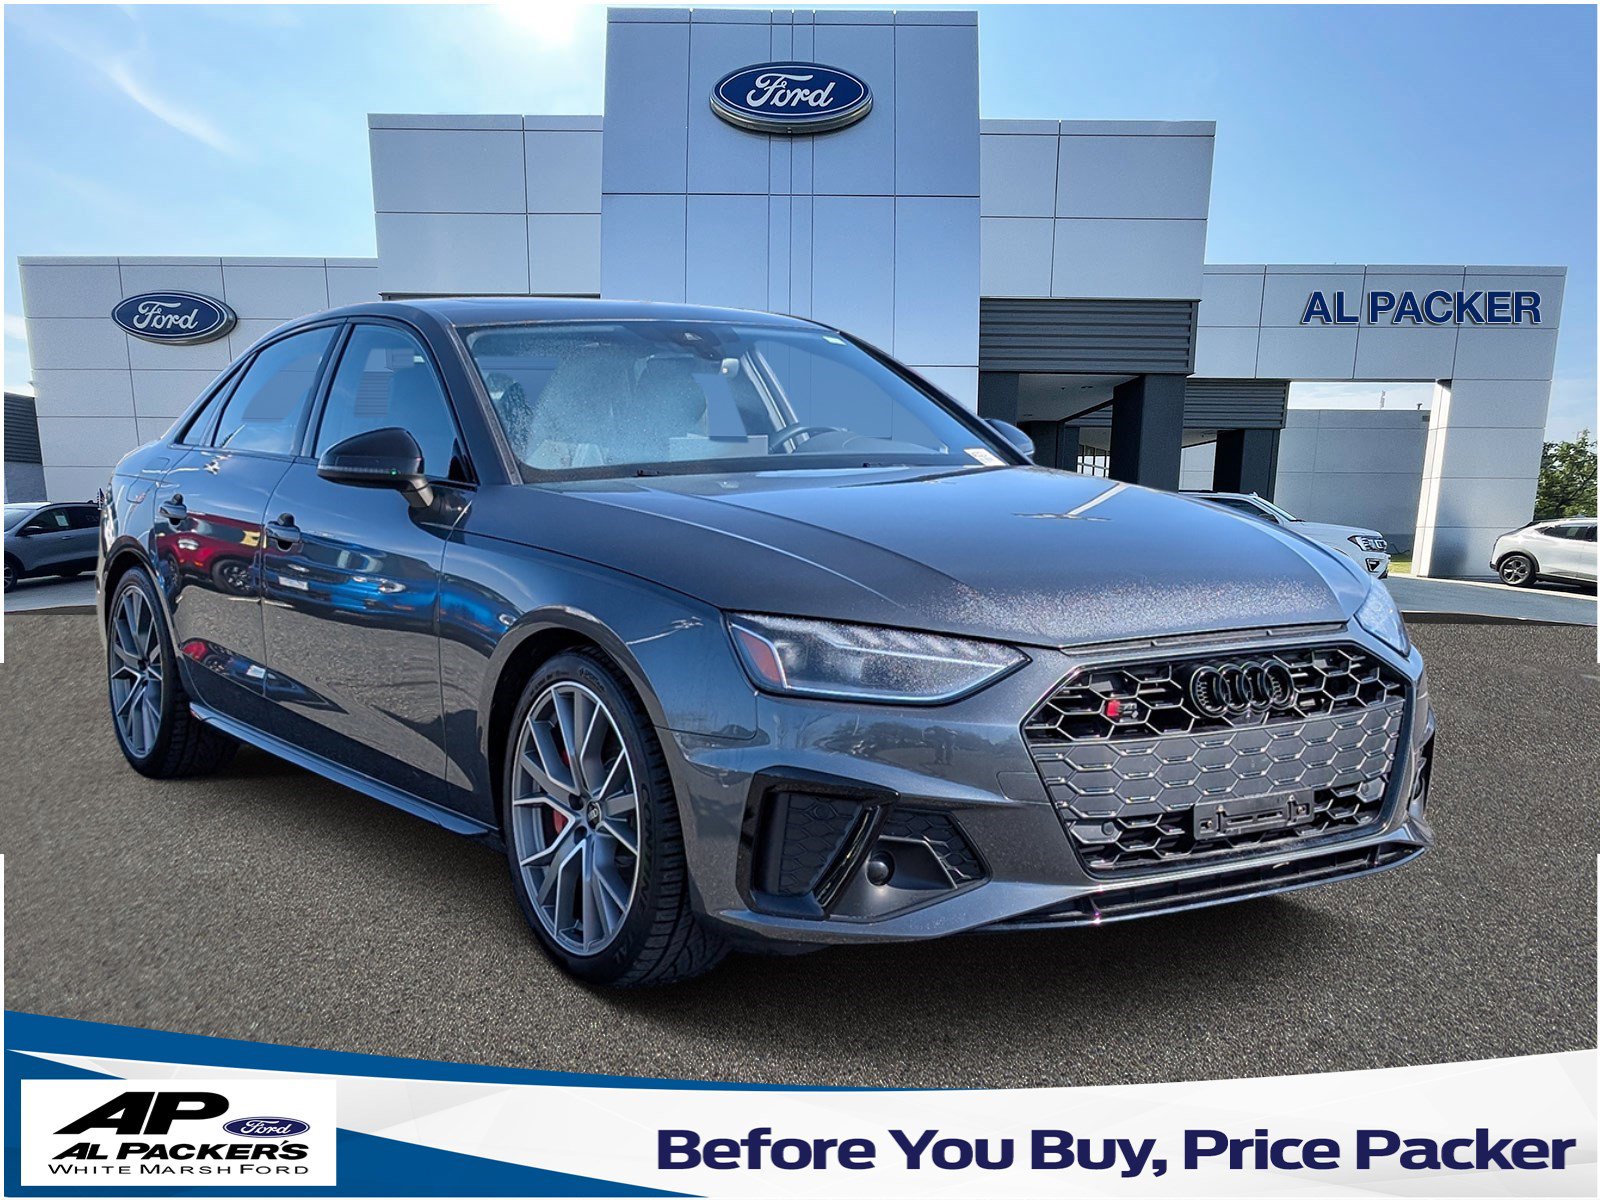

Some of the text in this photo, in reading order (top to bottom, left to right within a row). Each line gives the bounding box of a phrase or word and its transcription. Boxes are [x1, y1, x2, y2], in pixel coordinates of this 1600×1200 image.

[746, 73, 836, 107] Ford
[133, 301, 199, 329] Ford
[1302, 290, 1542, 325] AL PACKER
